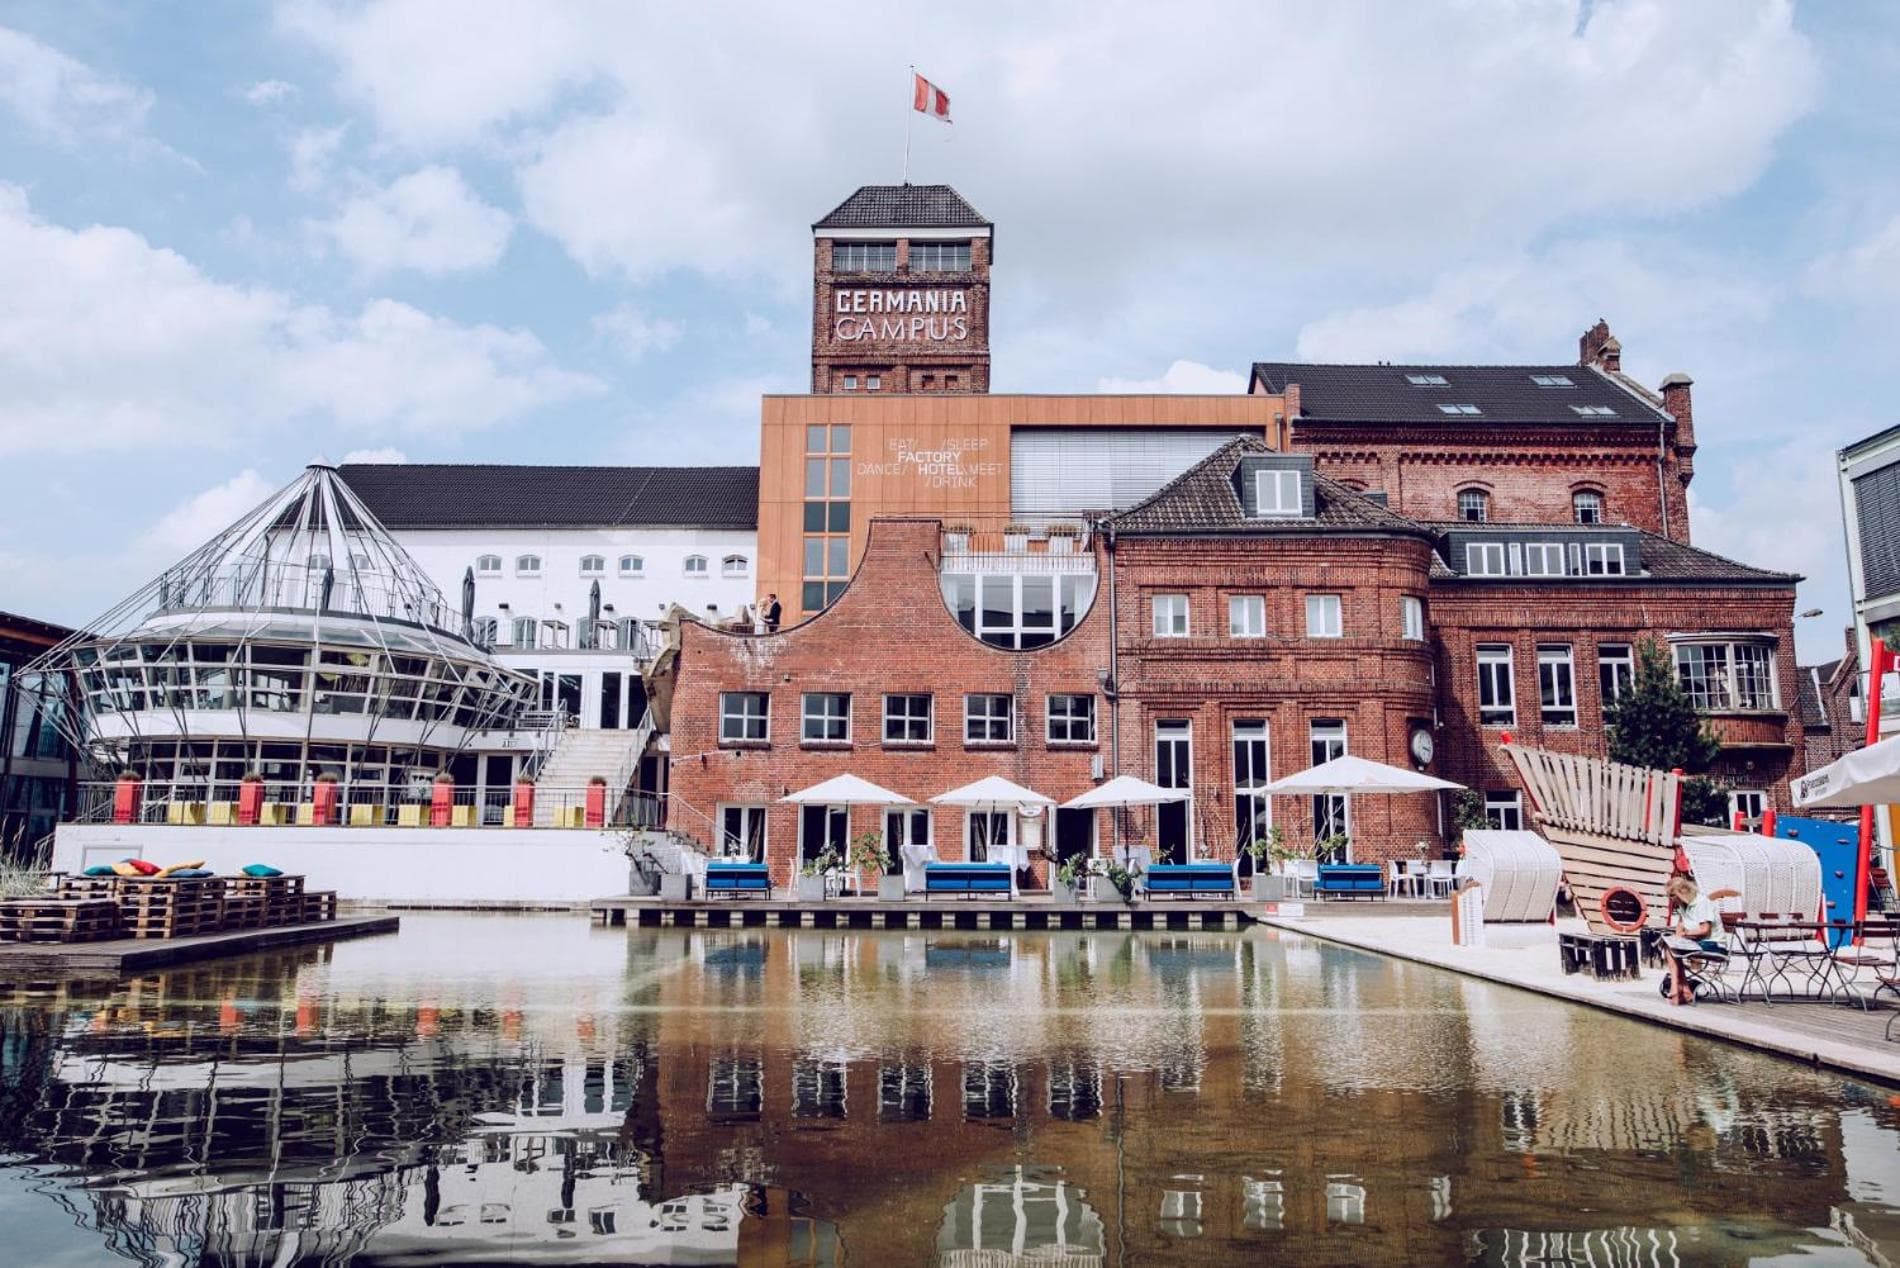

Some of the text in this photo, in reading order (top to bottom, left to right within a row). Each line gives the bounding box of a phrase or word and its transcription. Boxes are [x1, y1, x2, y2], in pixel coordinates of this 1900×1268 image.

[836, 289, 967, 314] GERMANIA
[836, 316, 969, 341] CAMPUS
[897, 451, 961, 463] FACTORY
[918, 463, 963, 475] HOTEL
